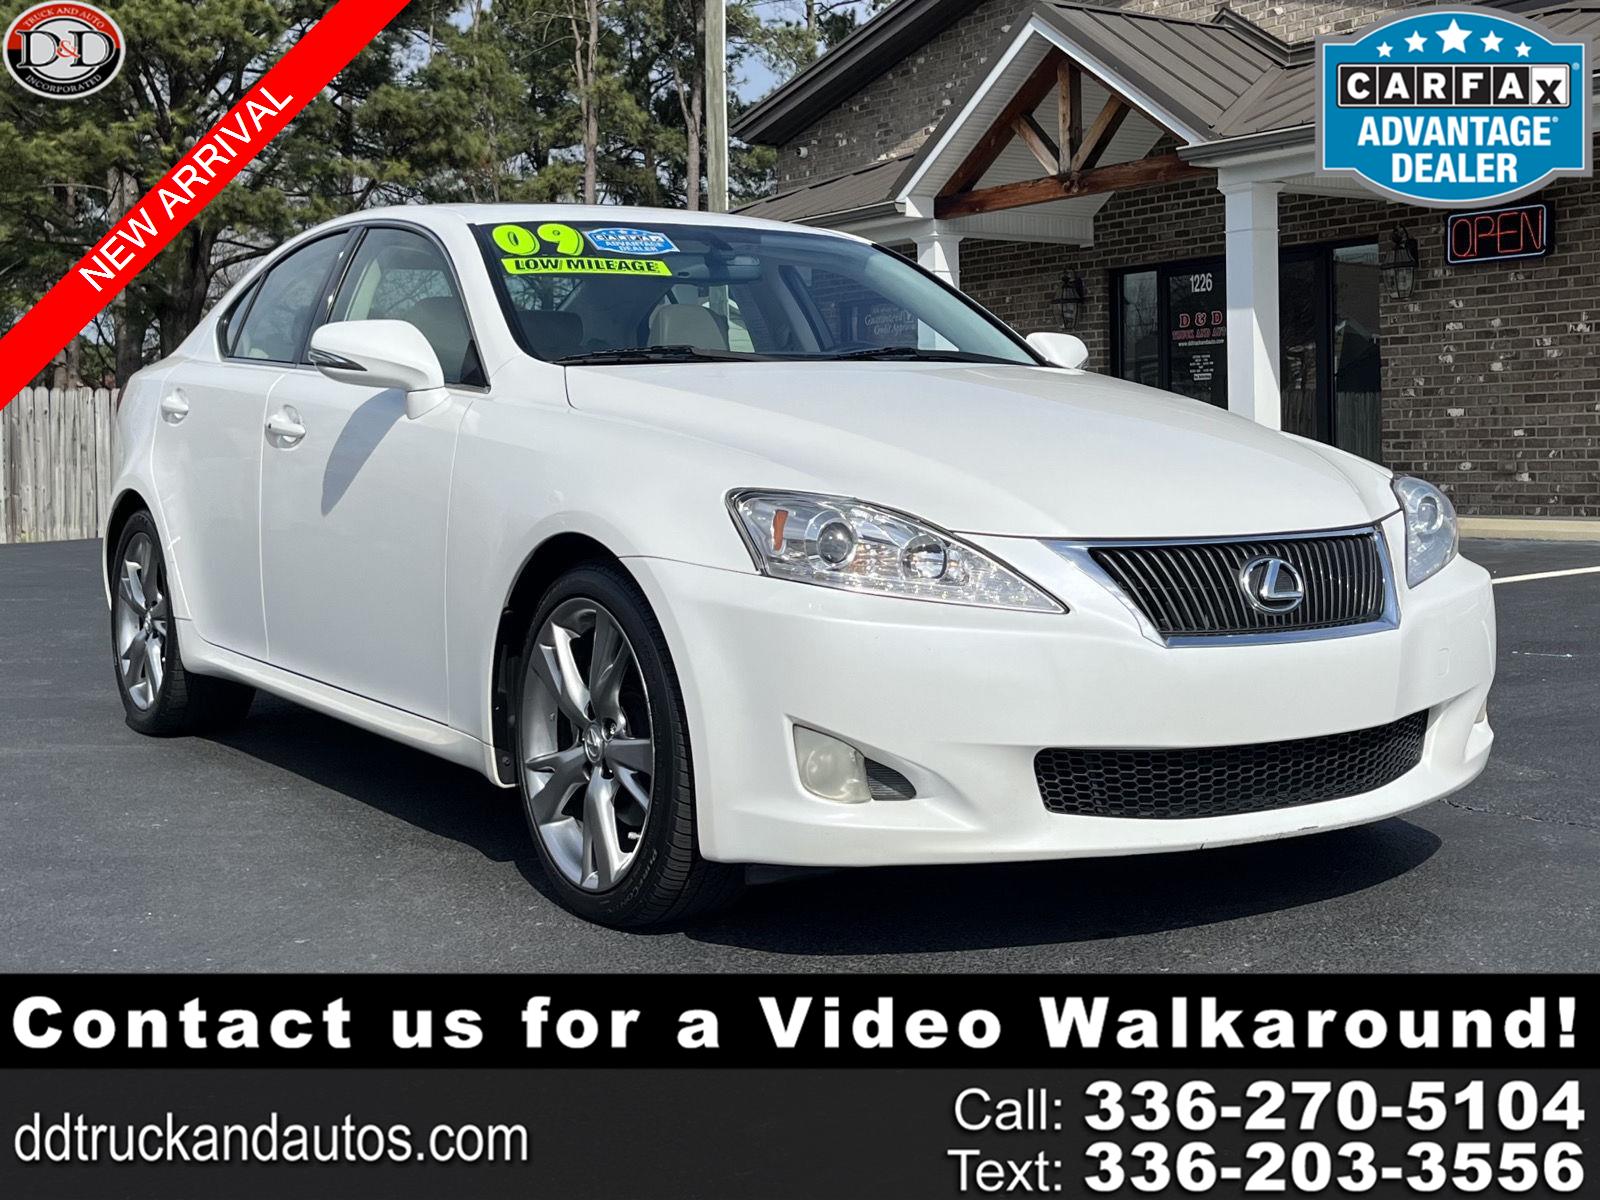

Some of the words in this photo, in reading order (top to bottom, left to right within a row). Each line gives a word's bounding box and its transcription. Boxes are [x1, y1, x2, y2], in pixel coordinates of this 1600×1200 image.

[492, 223, 584, 255] 09
[595, 233, 665, 243] CARFAX
[1451, 208, 1544, 258] OPEN
[514, 259, 561, 271] LOW
[566, 259, 658, 272] MILEAGE
[1190, 273, 1212, 292] 1226
[1179, 313, 1191, 328] D
[1211, 310, 1223, 325] D
